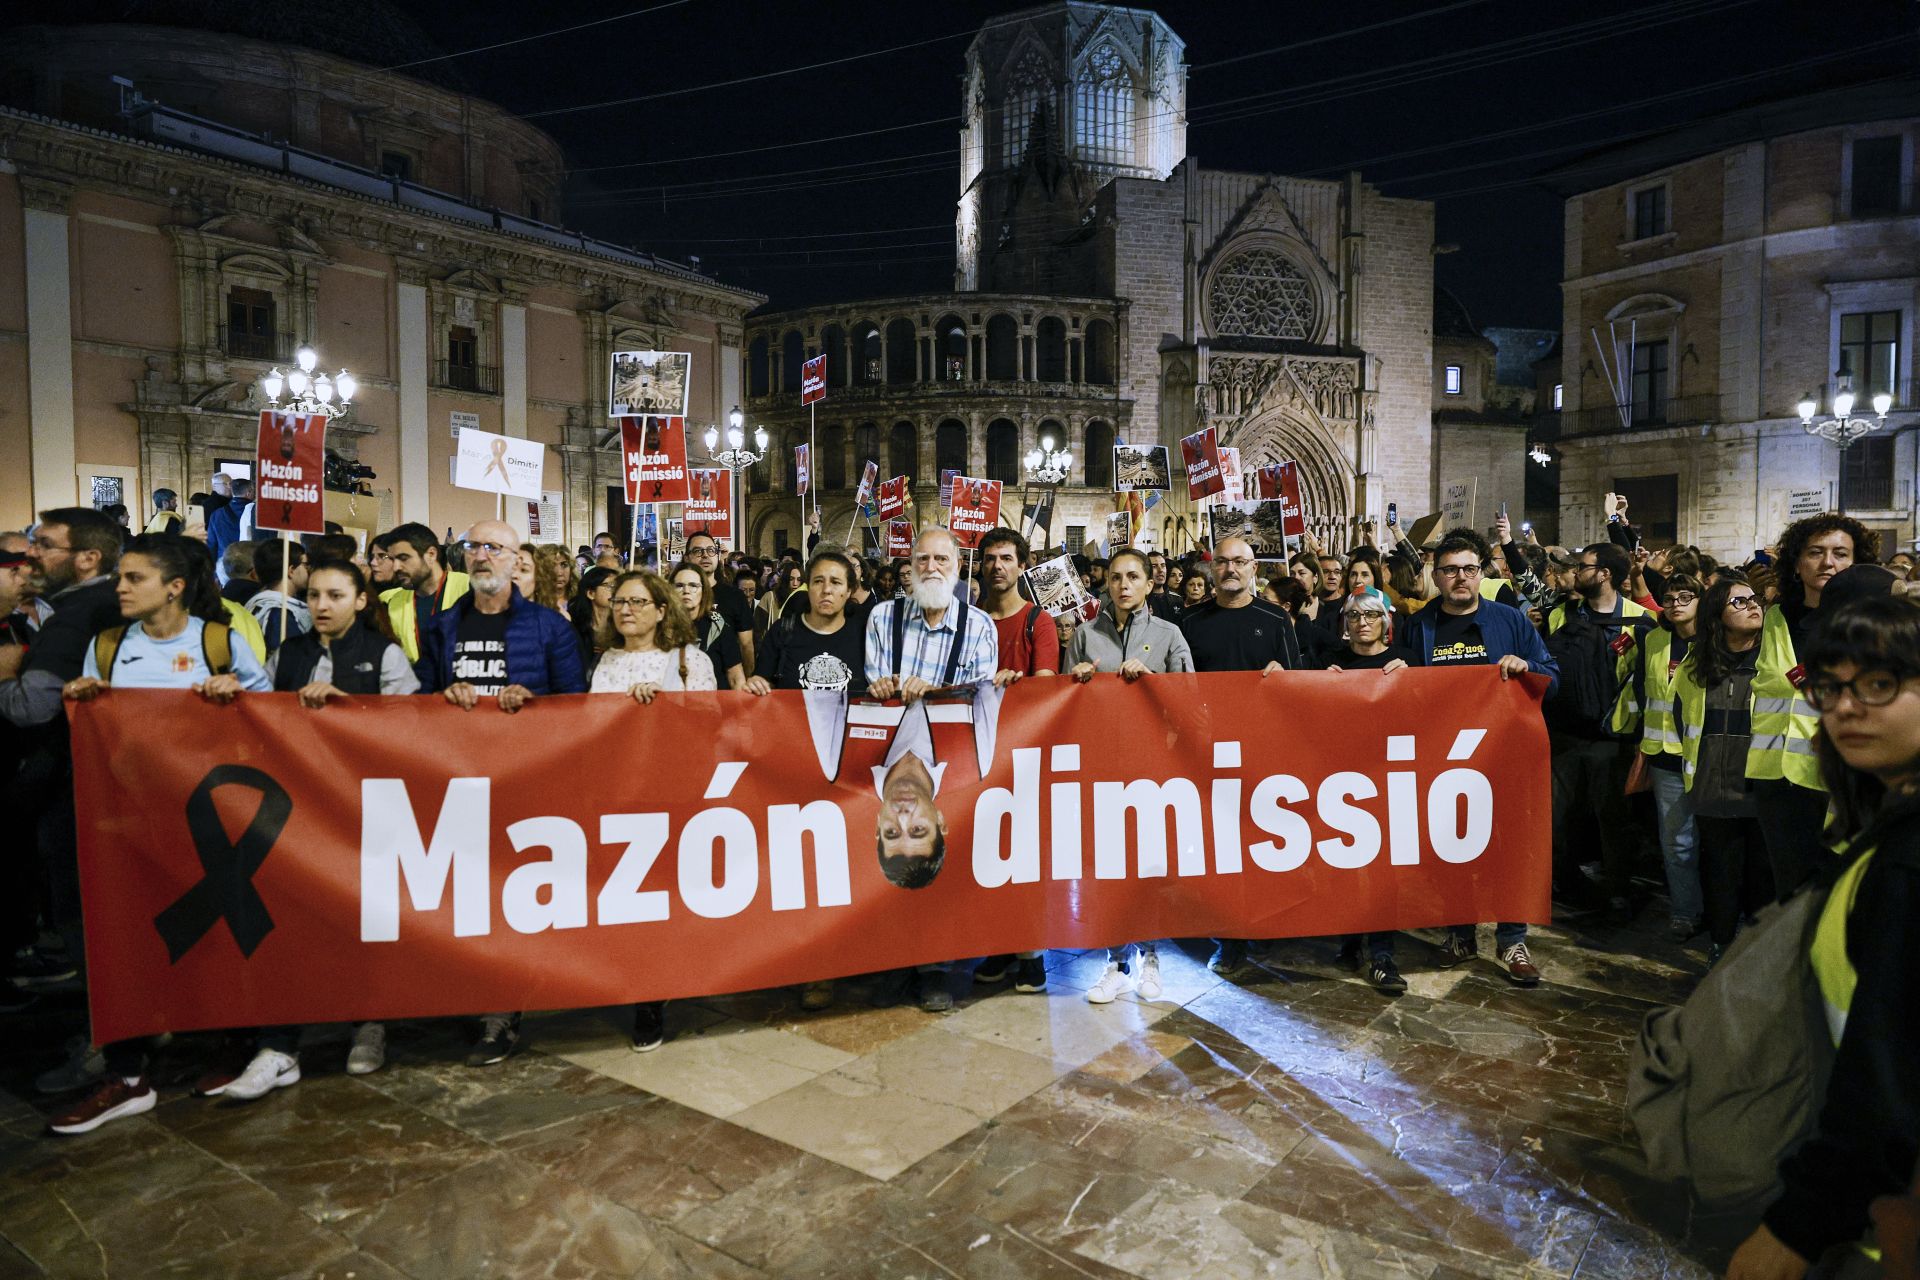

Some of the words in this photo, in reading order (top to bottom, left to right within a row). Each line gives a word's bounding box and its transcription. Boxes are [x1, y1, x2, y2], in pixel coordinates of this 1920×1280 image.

[649, 397, 681, 409] 2024
[261, 459, 303, 480] Mazón
[507, 456, 539, 470] Dimitir
[1188, 458, 1210, 475] Mazón
[629, 465, 684, 482] dmissió
[1190, 465, 1219, 486] dimissió
[1149, 477, 1168, 487] 2024
[261, 480, 319, 504] dimissió
[686, 496, 716, 509] Mazón
[686, 509, 728, 521] dimissió
[953, 506, 985, 520] Mazón
[1256, 543, 1282, 554] 2024
[360, 761, 852, 943] Mazón
[972, 728, 1493, 889] dimissió
